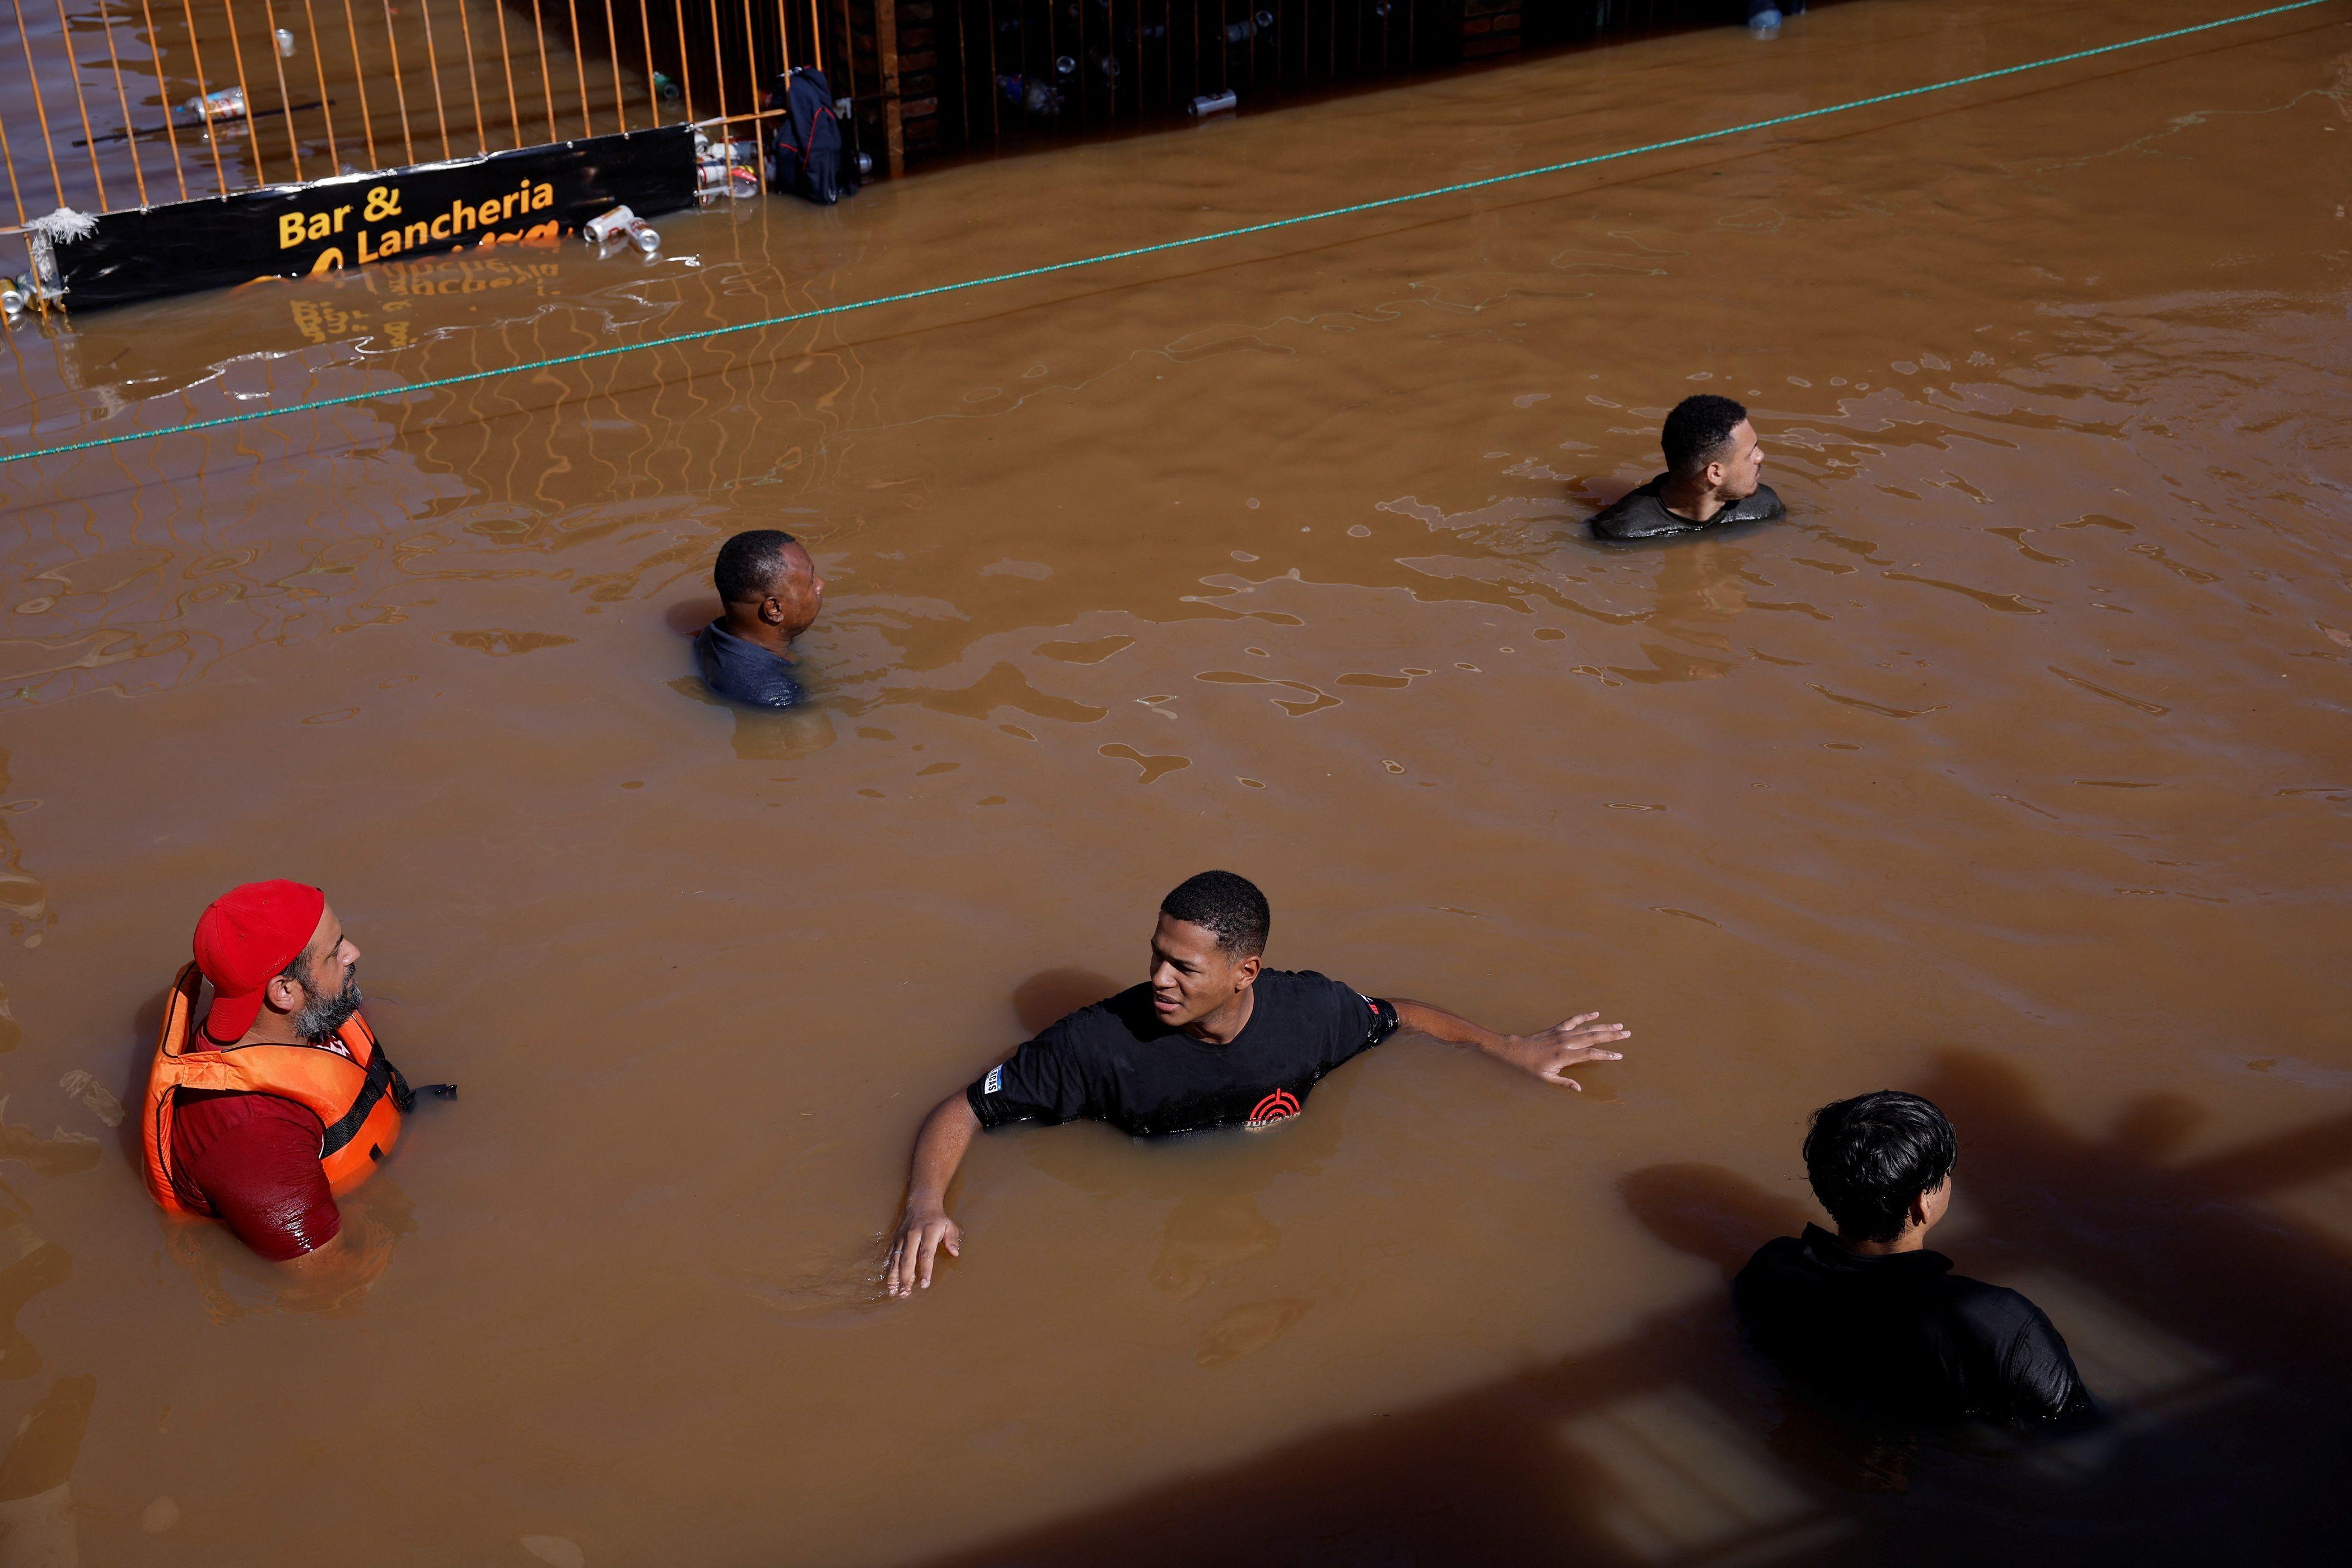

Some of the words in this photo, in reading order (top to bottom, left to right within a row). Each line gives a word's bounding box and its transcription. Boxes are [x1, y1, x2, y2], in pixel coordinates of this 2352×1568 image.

[279, 205, 351, 249] Bar
[363, 186, 402, 222] &
[358, 179, 553, 264] Lancheria
